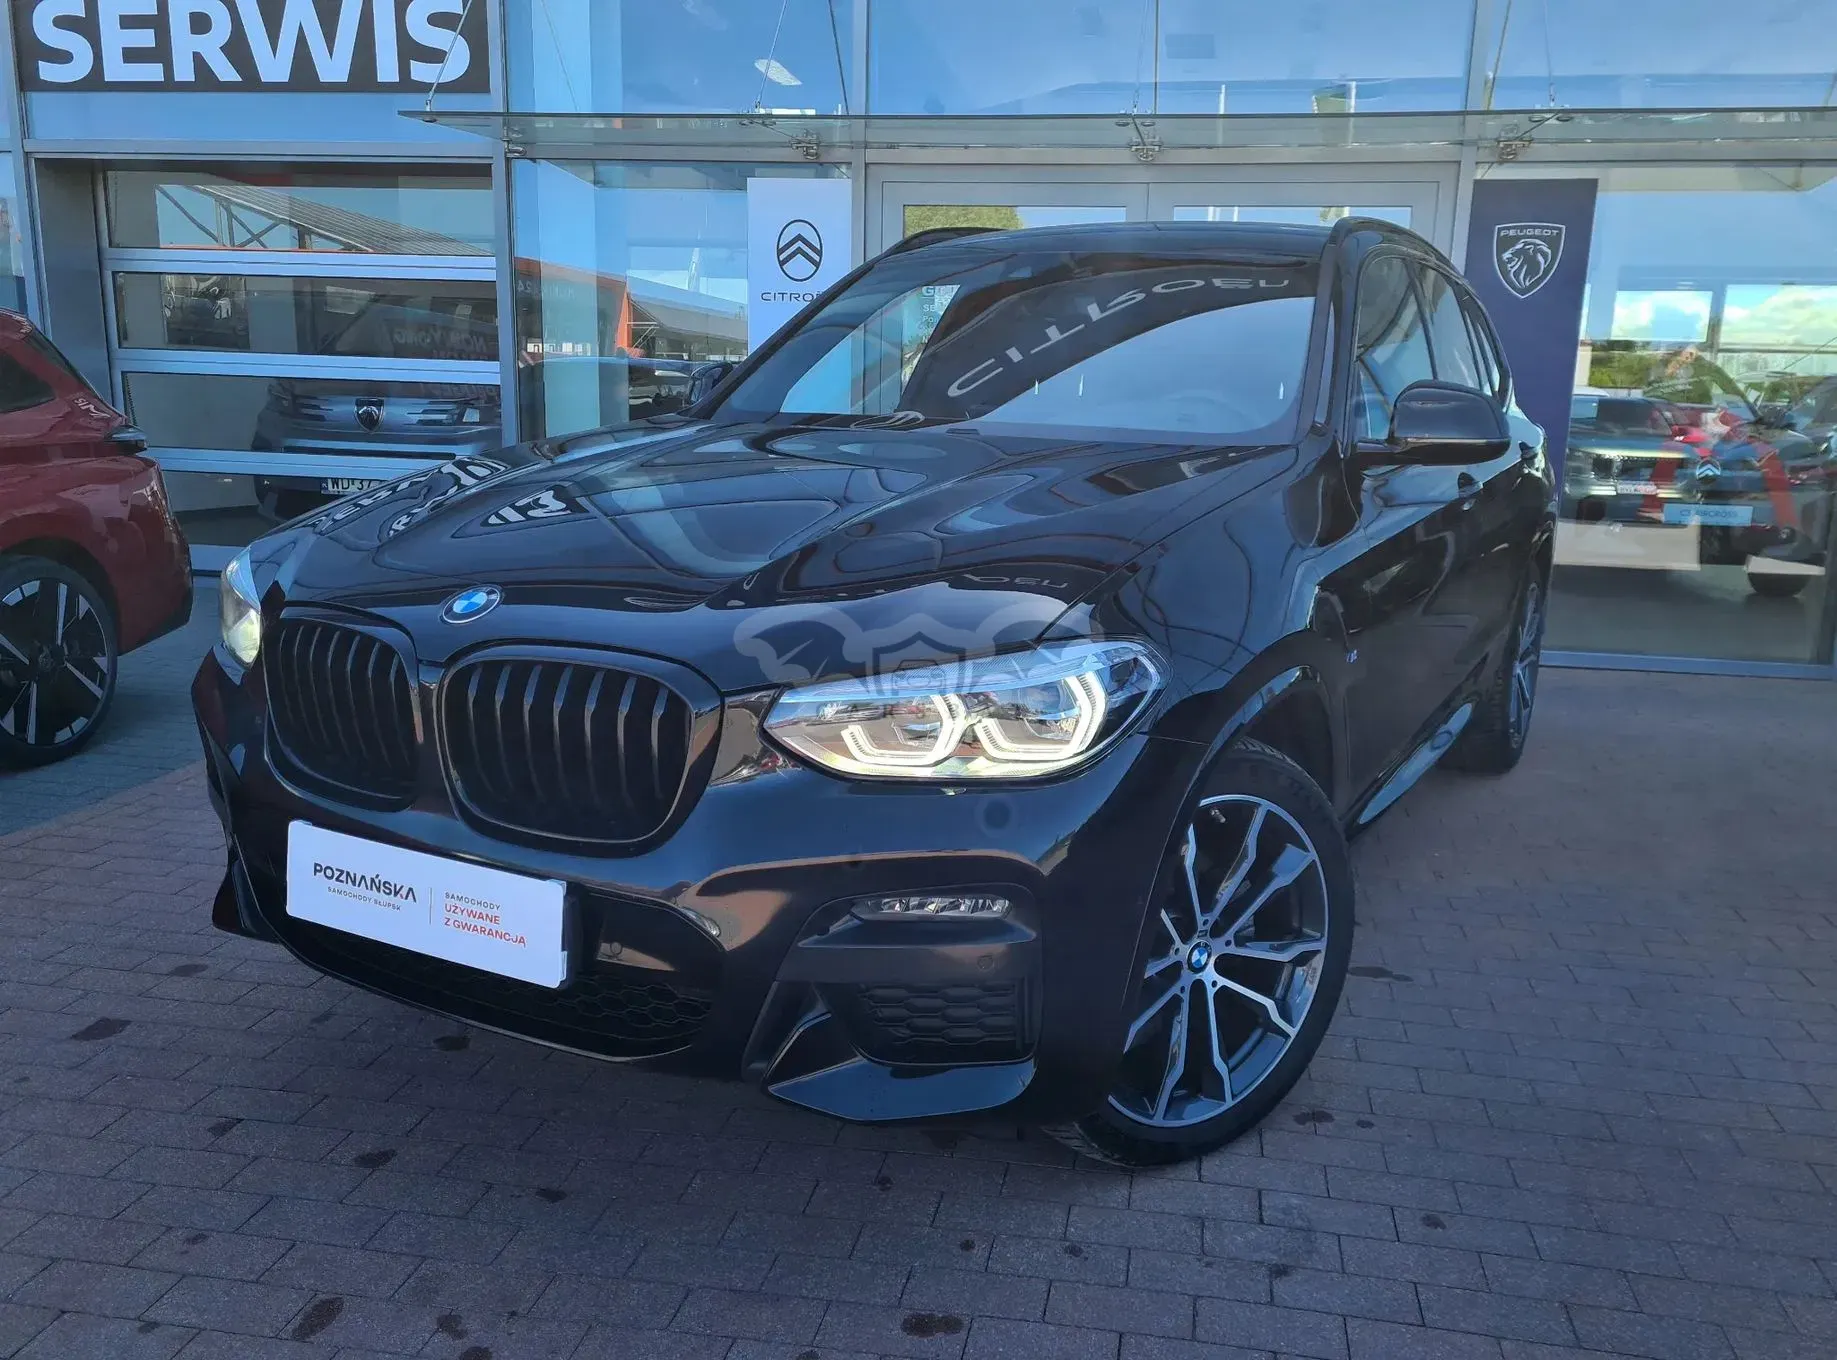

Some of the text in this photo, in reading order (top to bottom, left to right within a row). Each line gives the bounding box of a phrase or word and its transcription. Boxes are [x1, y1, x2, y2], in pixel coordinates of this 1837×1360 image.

[31, 0, 471, 84] SERWIS
[1500, 228, 1560, 237] PEUGEOT
[313, 862, 417, 903] POZNAŃSKA
[327, 886, 372, 904] SAMOCHODY
[445, 892, 501, 911] SAMOCHODY
[444, 903, 501, 925] UŻYWANE
[444, 917, 527, 948] Z GWARANCJĄ
